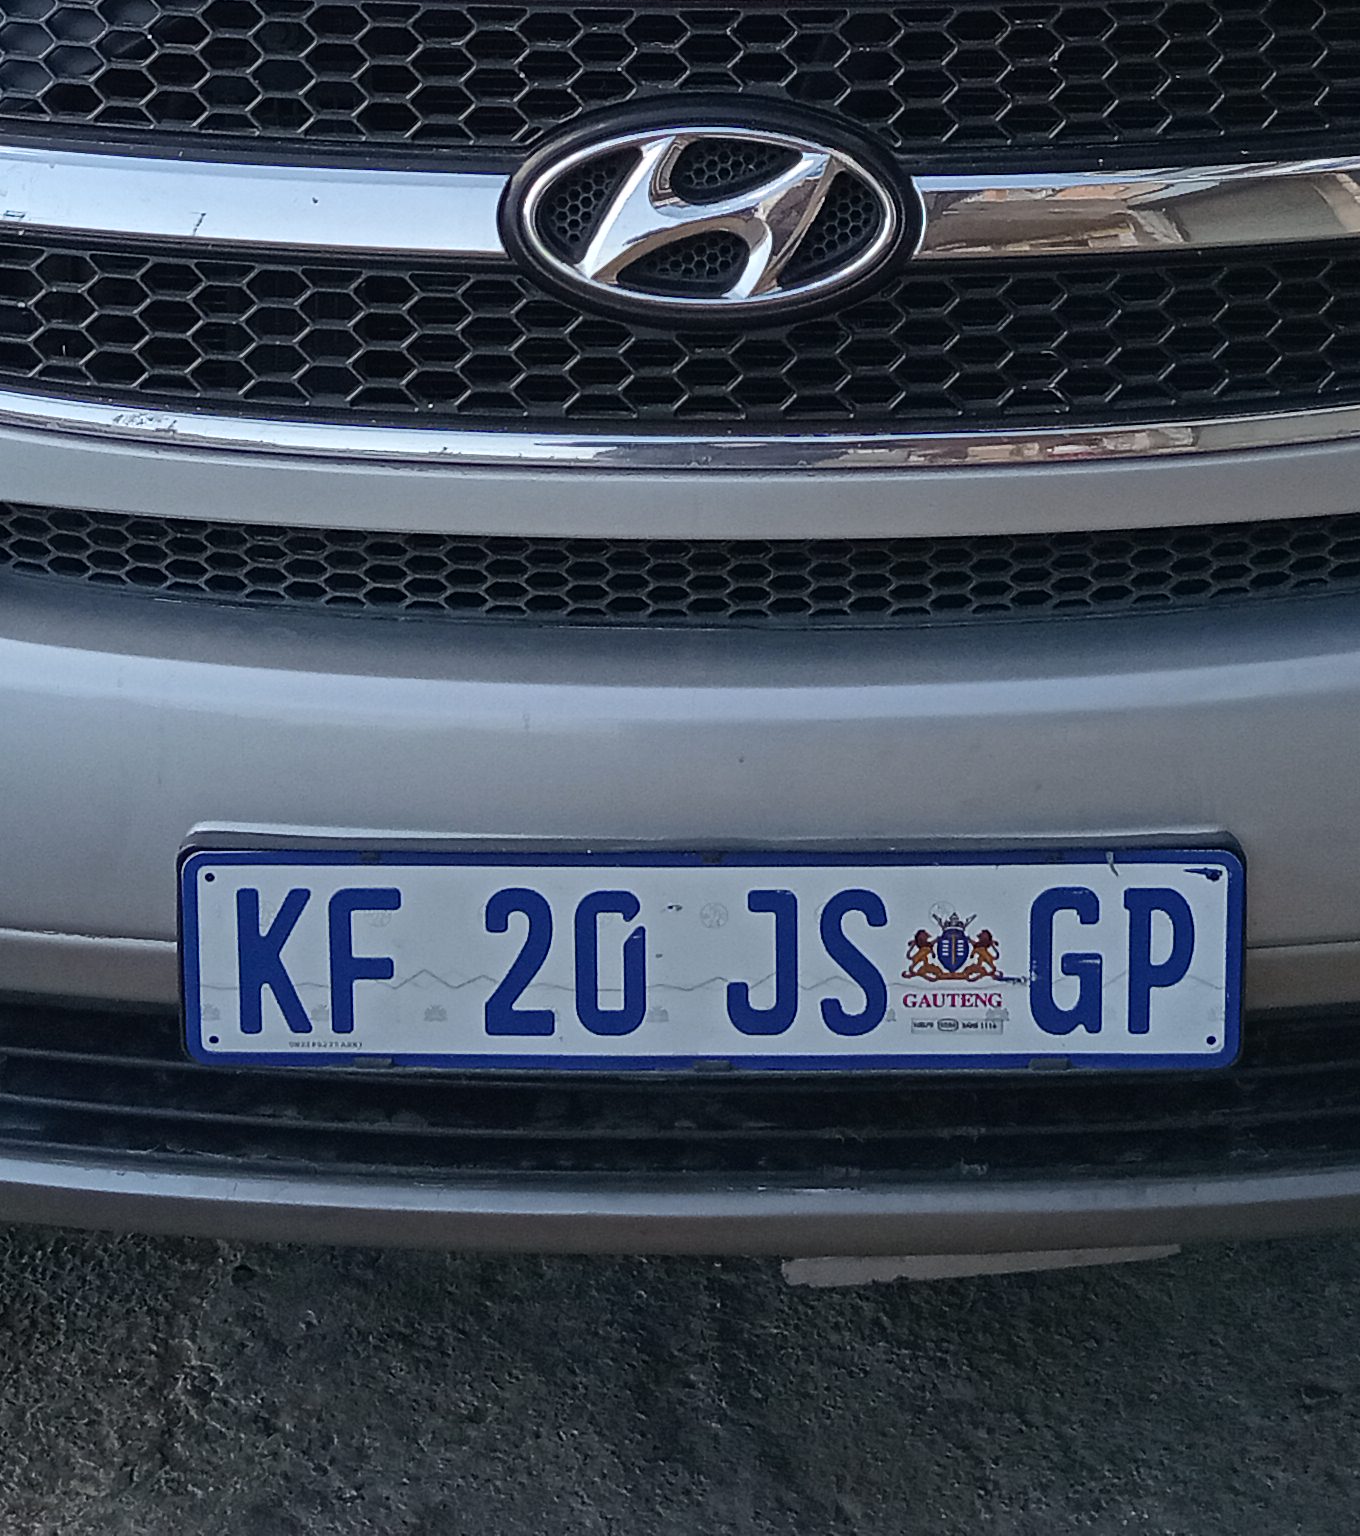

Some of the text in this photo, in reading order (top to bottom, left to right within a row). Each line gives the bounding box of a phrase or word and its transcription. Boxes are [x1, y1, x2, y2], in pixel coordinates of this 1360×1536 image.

[235, 886, 1196, 1037] KF 20 JS GP
[902, 993, 1003, 1008] GAUTENG
